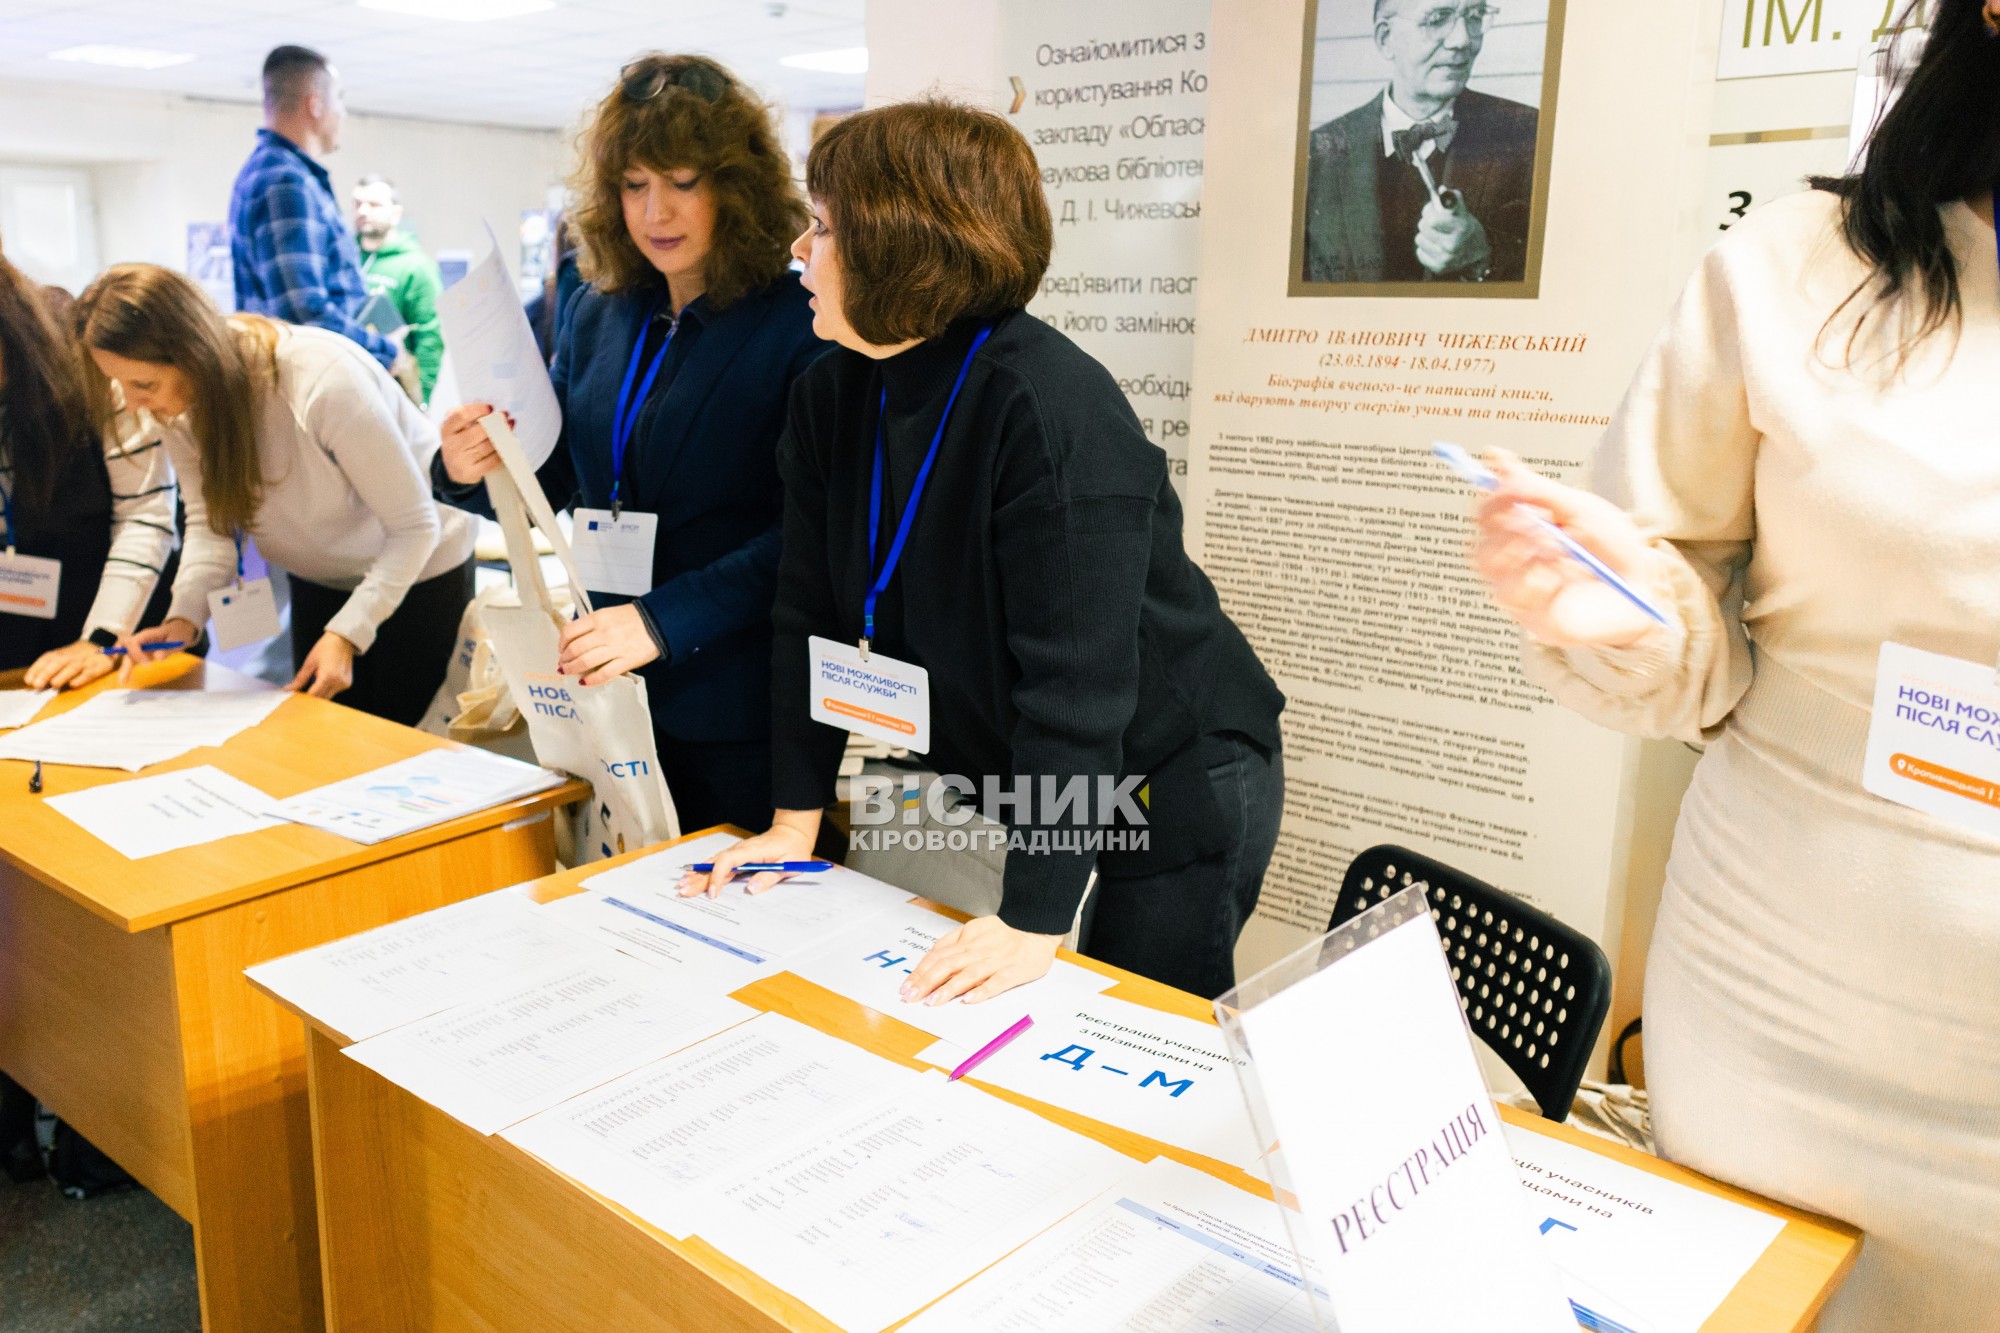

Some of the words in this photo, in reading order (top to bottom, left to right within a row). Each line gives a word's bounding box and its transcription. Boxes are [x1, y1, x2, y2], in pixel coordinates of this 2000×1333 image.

[1036, 34, 1187, 66] Ознайомитися
[1035, 78, 1173, 110] користування
[1180, 70, 1208, 93] Ко
[1034, 125, 1113, 146] закладу
[1039, 272, 1141, 298] ред'явити
[1064, 311, 1107, 335] його
[1243, 327, 1320, 344] ДМИТРО
[1327, 329, 1427, 347] ІВАНОВИЧ
[1438, 332, 1588, 353] ЧИЖЕВСЬКИЙ
[1267, 374, 1335, 391] Біографія
[1425, 384, 1497, 398] написані
[1236, 392, 1295, 409] дарують
[1299, 398, 1351, 412] творчу
[1413, 404, 1462, 418] учням
[1467, 408, 1491, 420] та
[1496, 408, 1611, 426] послідовника
[821, 660, 845, 673] НОВІ
[847, 667, 917, 695] МОЖЛИВОСТІ
[821, 670, 851, 686] ПІСЛЯ
[853, 680, 897, 699] СЛУЖБИ
[534, 702, 582, 724] ПІСЛ
[1899, 685, 1950, 712] НОВІ
[1896, 704, 1960, 735] ПІСЛЯ
[1907, 763, 1987, 797] Кропивницький
[904, 926, 939, 944] Реєст
[1076, 1012, 1161, 1042] Реєстрація
[1164, 1037, 1247, 1067] учасників
[1091, 1031, 1189, 1065] прізвищами
[1193, 1061, 1214, 1072] на
[1040, 1044, 1096, 1072] Д
[1138, 1069, 1195, 1098] М
[1330, 1102, 1488, 1255] РЕЄСТРАЦІЯ
[1546, 1171, 1654, 1215] учасників
[1520, 1178, 1582, 1207] щами
[1586, 1205, 1613, 1218] на
